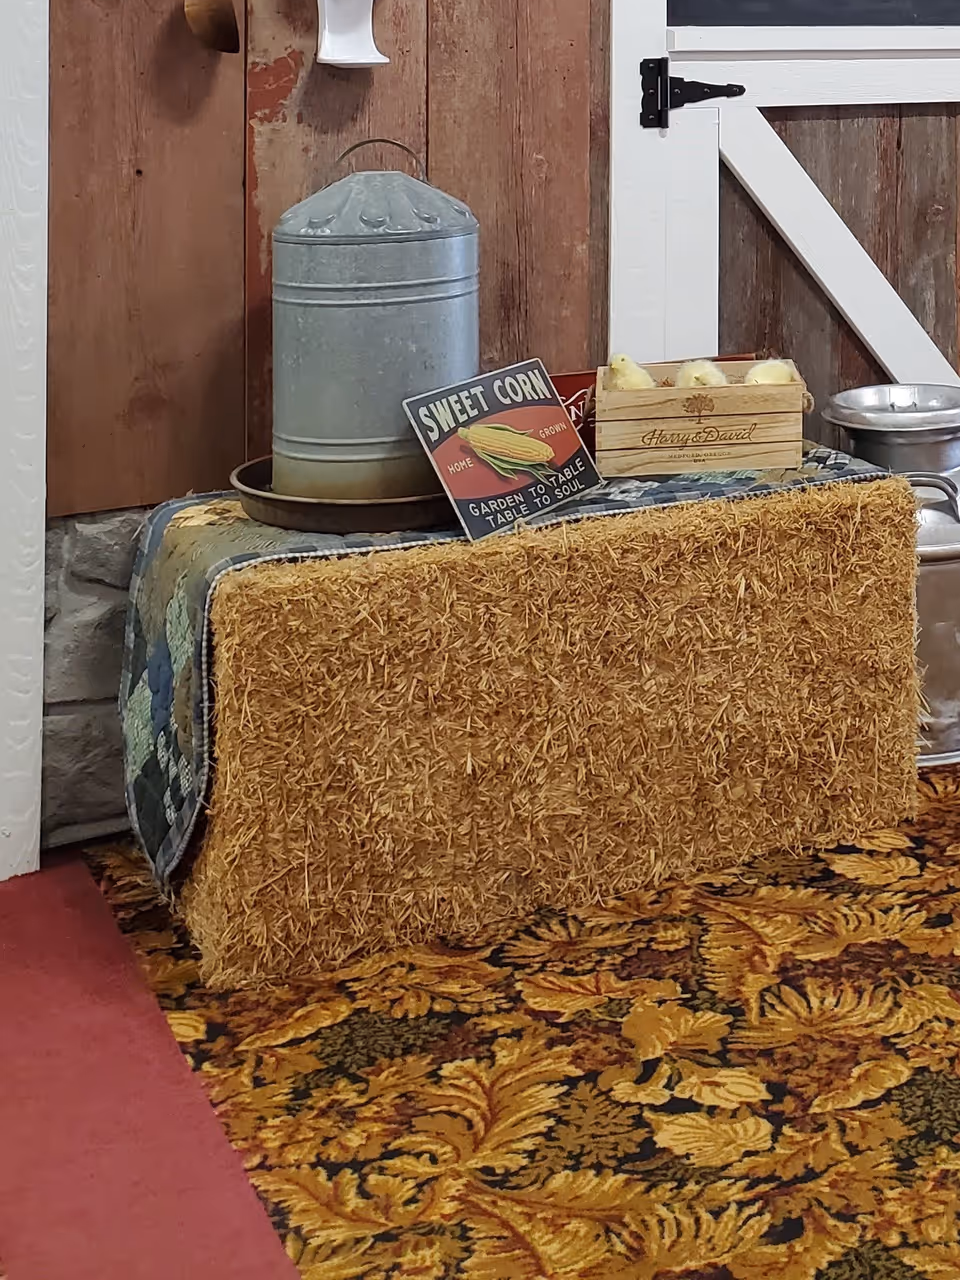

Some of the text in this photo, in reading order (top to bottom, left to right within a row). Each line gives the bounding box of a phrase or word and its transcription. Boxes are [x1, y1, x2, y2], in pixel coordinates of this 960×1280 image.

[418, 368, 552, 443] SWEET CORN
[538, 421, 568, 439] GROWN
[447, 457, 474, 475] HOME
[469, 457, 585, 517] GARDEN TO TABLE
[485, 478, 585, 528] TABLE TO SOUL
